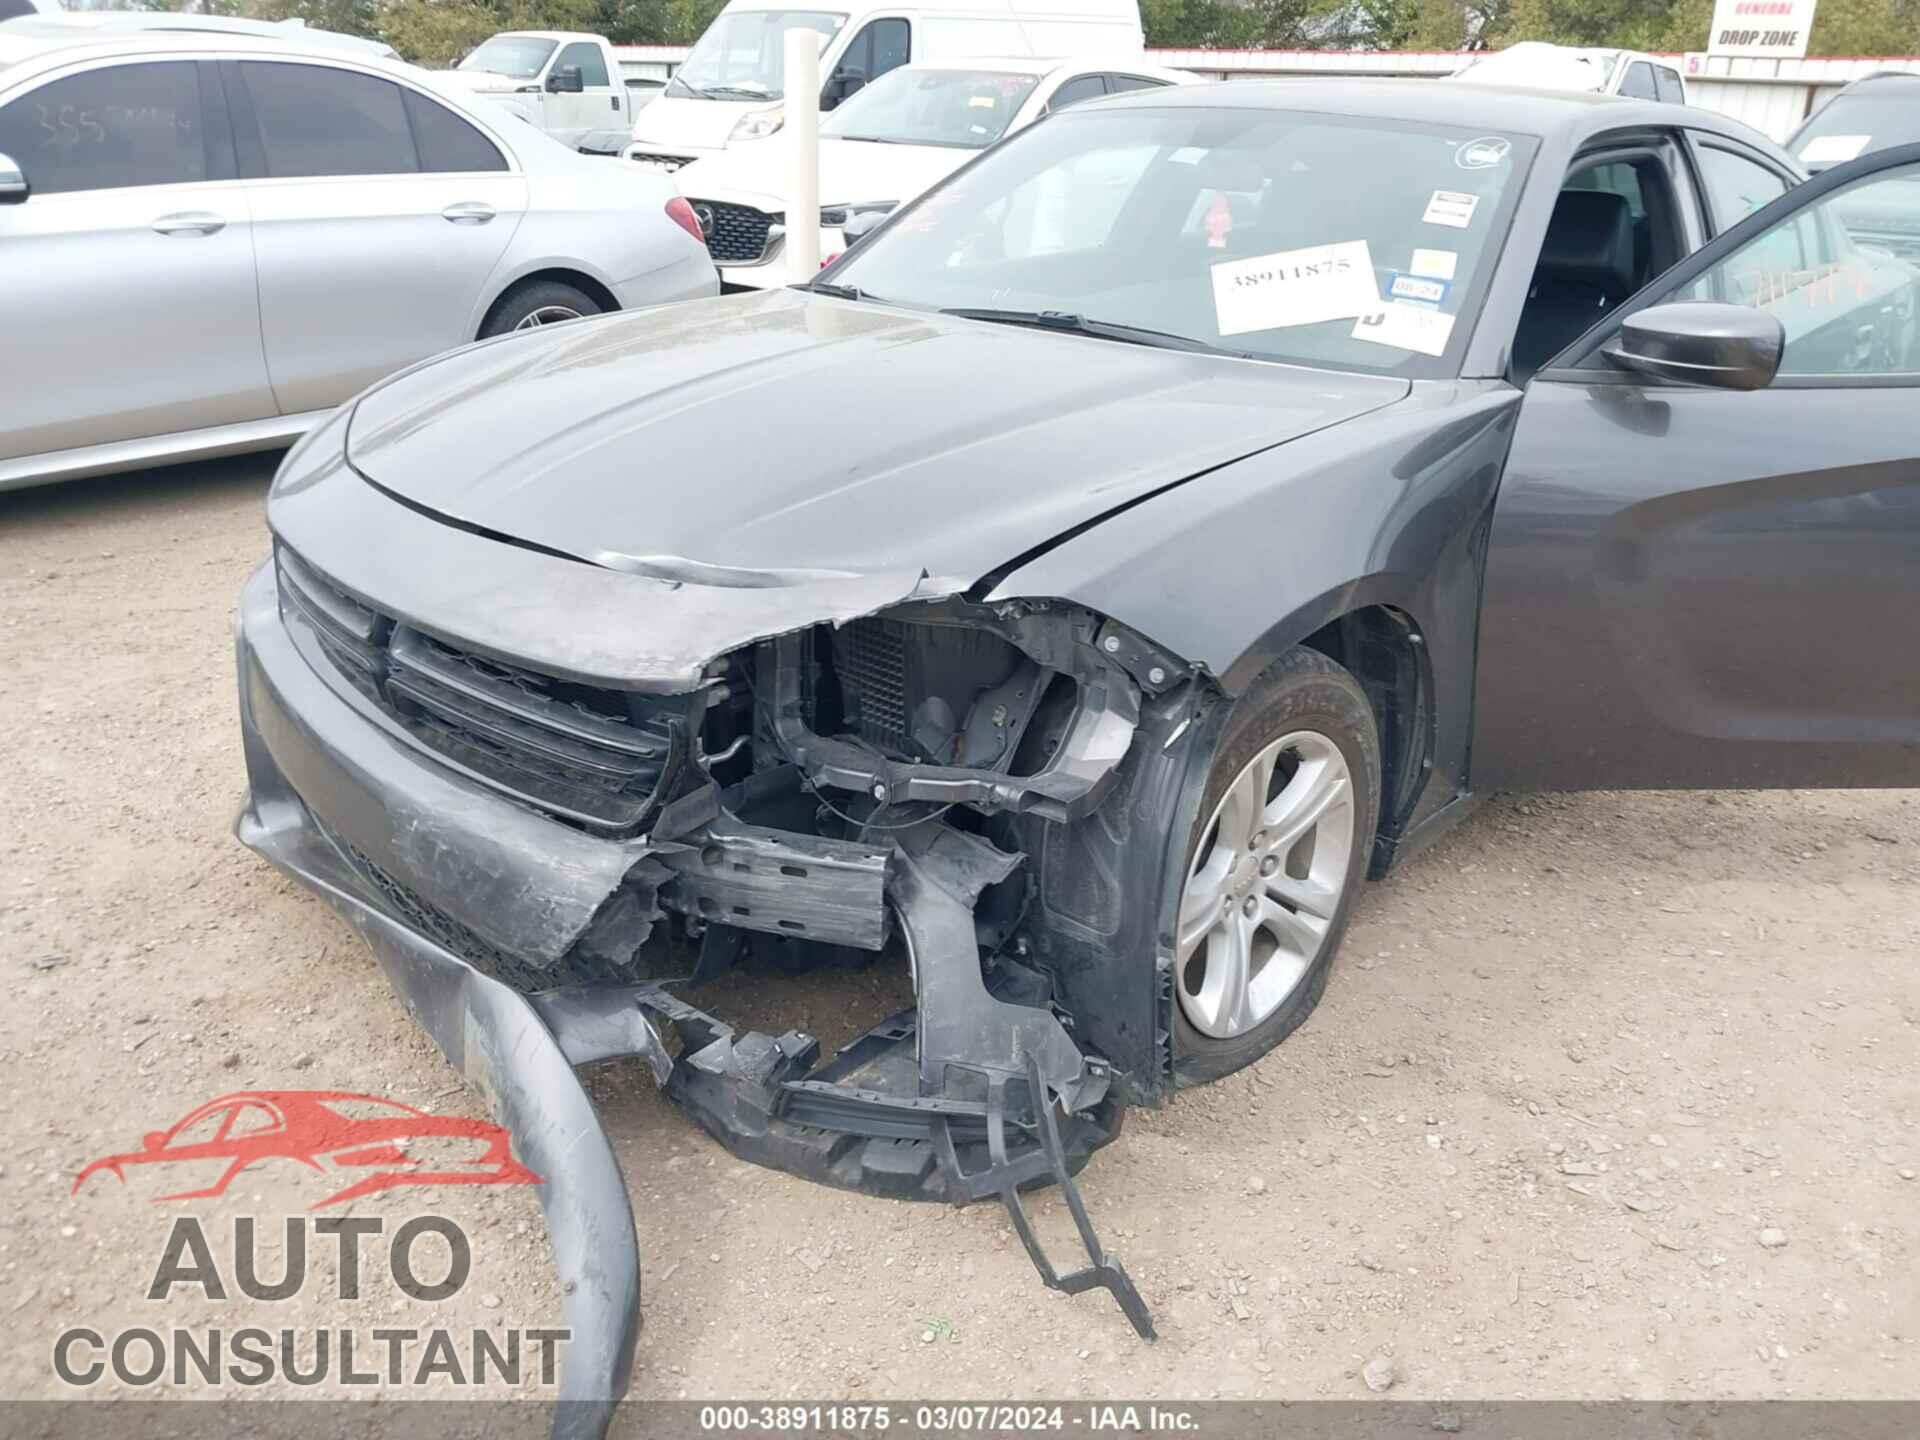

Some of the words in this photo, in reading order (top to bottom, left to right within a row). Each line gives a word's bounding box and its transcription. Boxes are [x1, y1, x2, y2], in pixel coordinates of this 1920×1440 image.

[1718, 29, 1760, 46] DROP
[1759, 30, 1799, 46] ZONE
[1689, 56, 1700, 73] 5
[1231, 257, 1352, 288] 38911875
